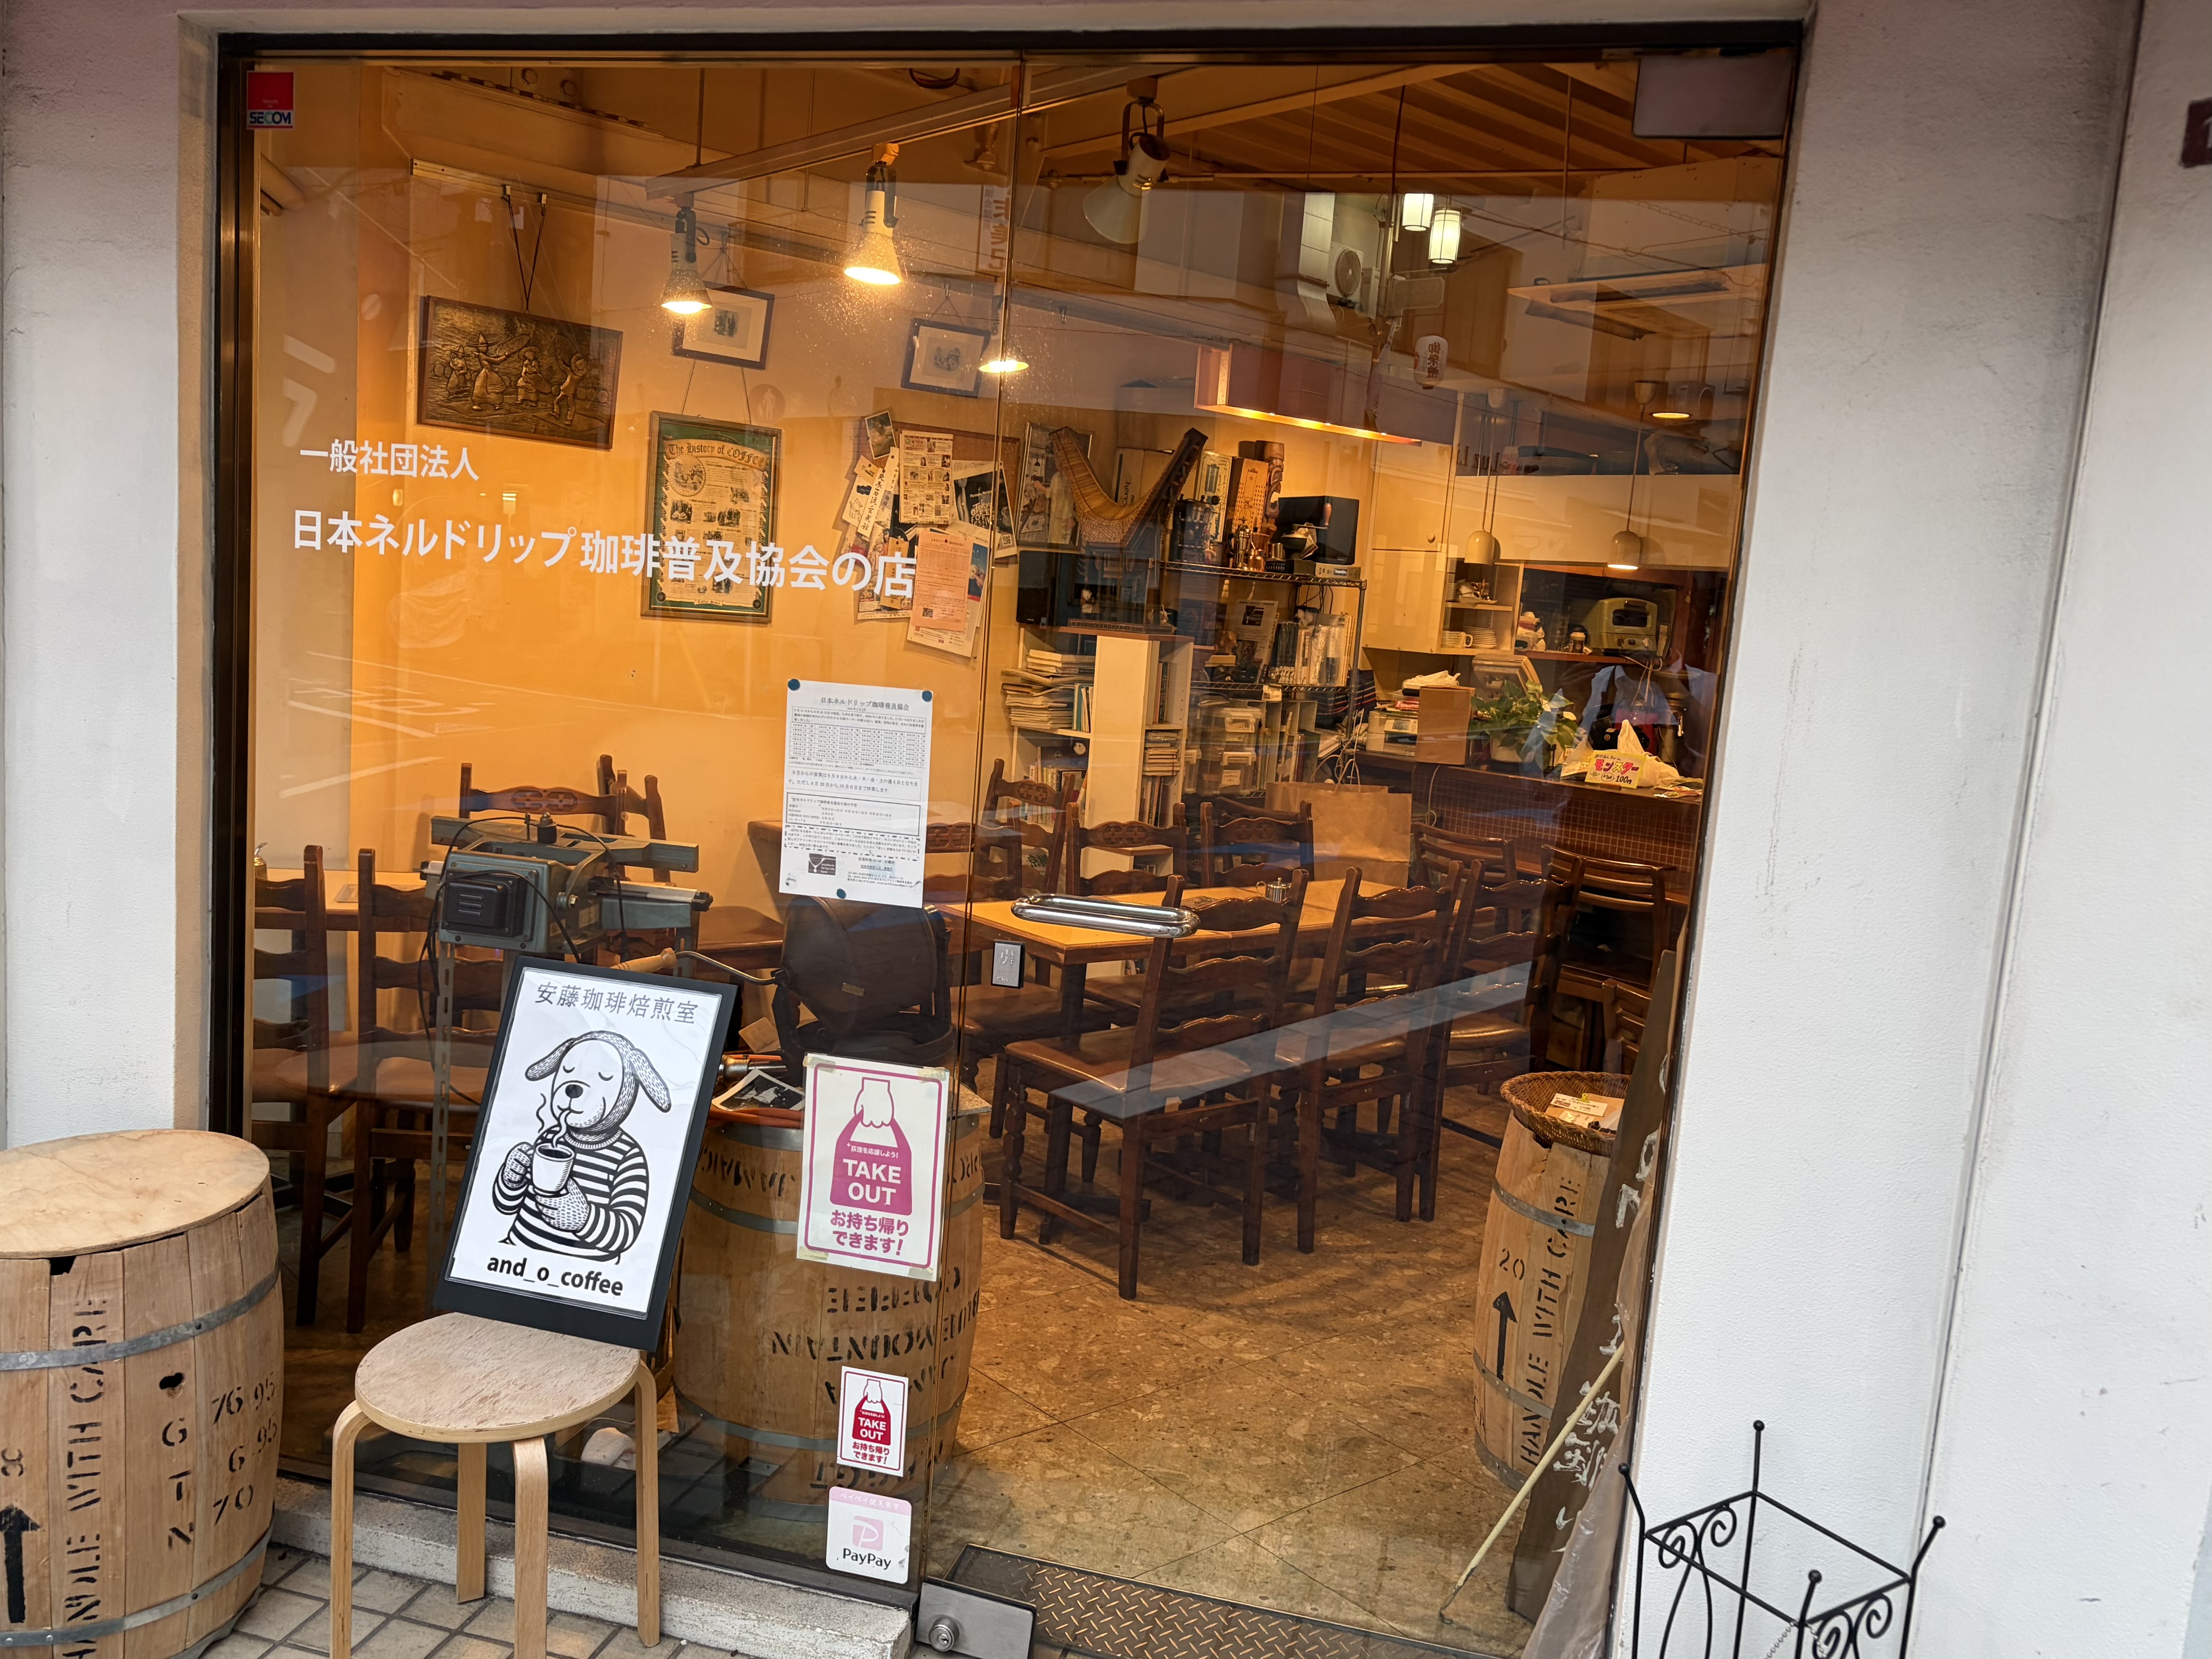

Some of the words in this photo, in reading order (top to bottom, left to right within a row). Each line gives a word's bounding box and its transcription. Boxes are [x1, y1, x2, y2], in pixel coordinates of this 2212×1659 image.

[250, 111, 291, 124] SECOM
[300, 439, 480, 481] 一般社団法人
[668, 443, 684, 455] The
[687, 443, 715, 454] History
[717, 445, 725, 455] of
[294, 510, 917, 598] 日本ネルドリップ珈琲普及協会の店
[821, 697, 910, 711] 日本ネルドリップ珈琲普及協会
[1595, 759, 1640, 775] モンスター
[535, 983, 699, 1024] 安藤珈琲焙煎室
[698, 1145, 796, 1197] JAMAIC
[843, 1159, 901, 1184] TAKE
[848, 1182, 896, 1206] OUT
[831, 1210, 909, 1236] お持ち帰り
[1499, 1248, 1525, 1280] 20
[1533, 1268, 1561, 1337] WITH
[858, 1417, 887, 1431] TAKE
[860, 1429, 884, 1441] OUT
[852, 1441, 890, 1455] お持ち帰り
[67, 1422, 102, 1512] WITH
[840, 1492, 900, 1510] ペイペイ使えます
[843, 1547, 891, 1570] PayPay
